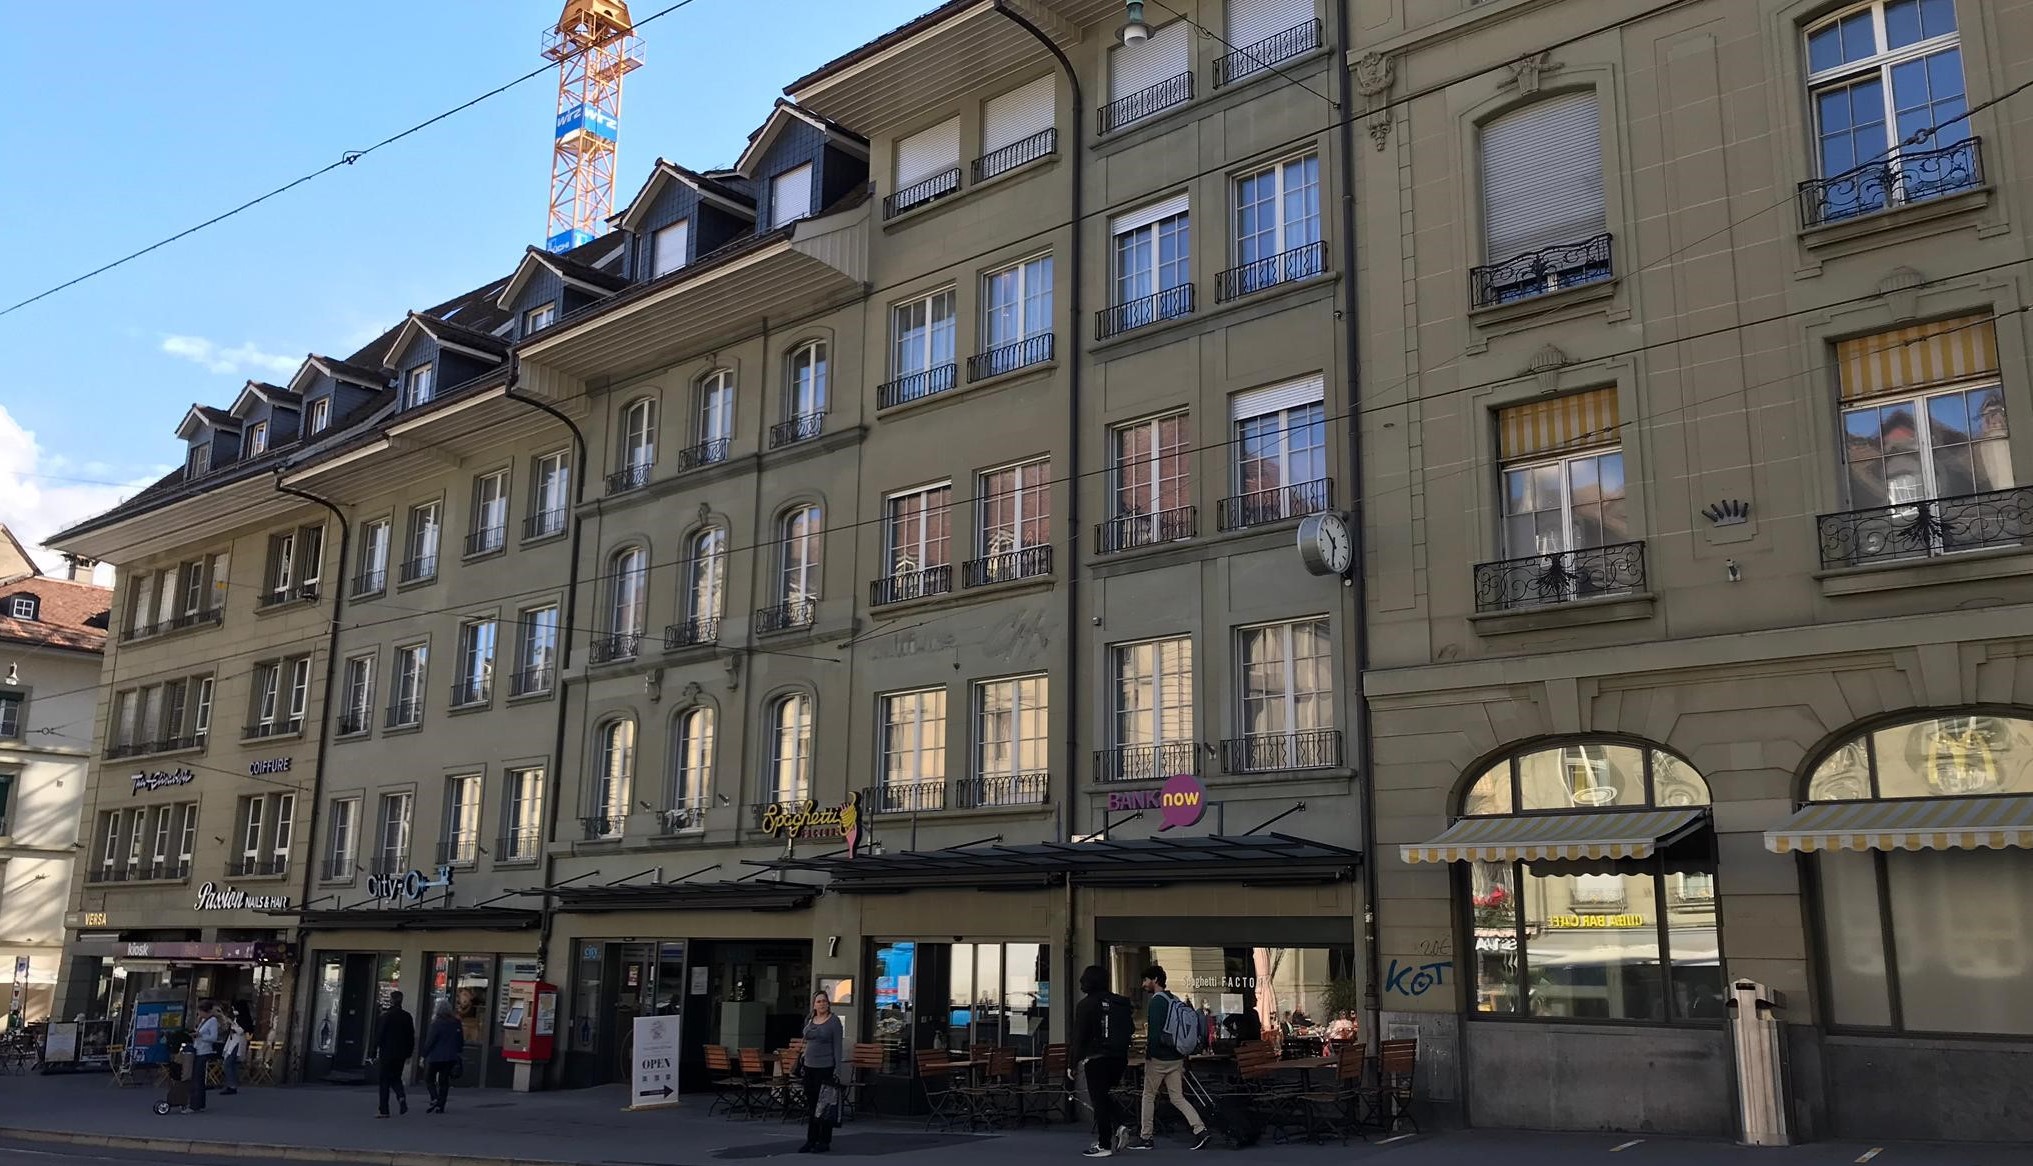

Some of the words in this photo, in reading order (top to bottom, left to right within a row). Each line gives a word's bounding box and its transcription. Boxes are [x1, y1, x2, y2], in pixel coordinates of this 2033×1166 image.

[584, 106, 618, 130] wirz
[249, 757, 290, 776] COIFFURE
[1108, 790, 1161, 811] BANK
[1163, 791, 1199, 806] now
[762, 800, 842, 838] Spaghetti
[194, 882, 245, 911] Passion
[245, 896, 264, 909] NAILS
[263, 896, 270, 908] &
[85, 912, 107, 927] VERSA
[127, 942, 149, 957] kiosk
[828, 936, 838, 957] 7
[641, 1058, 671, 1071] OPEN
